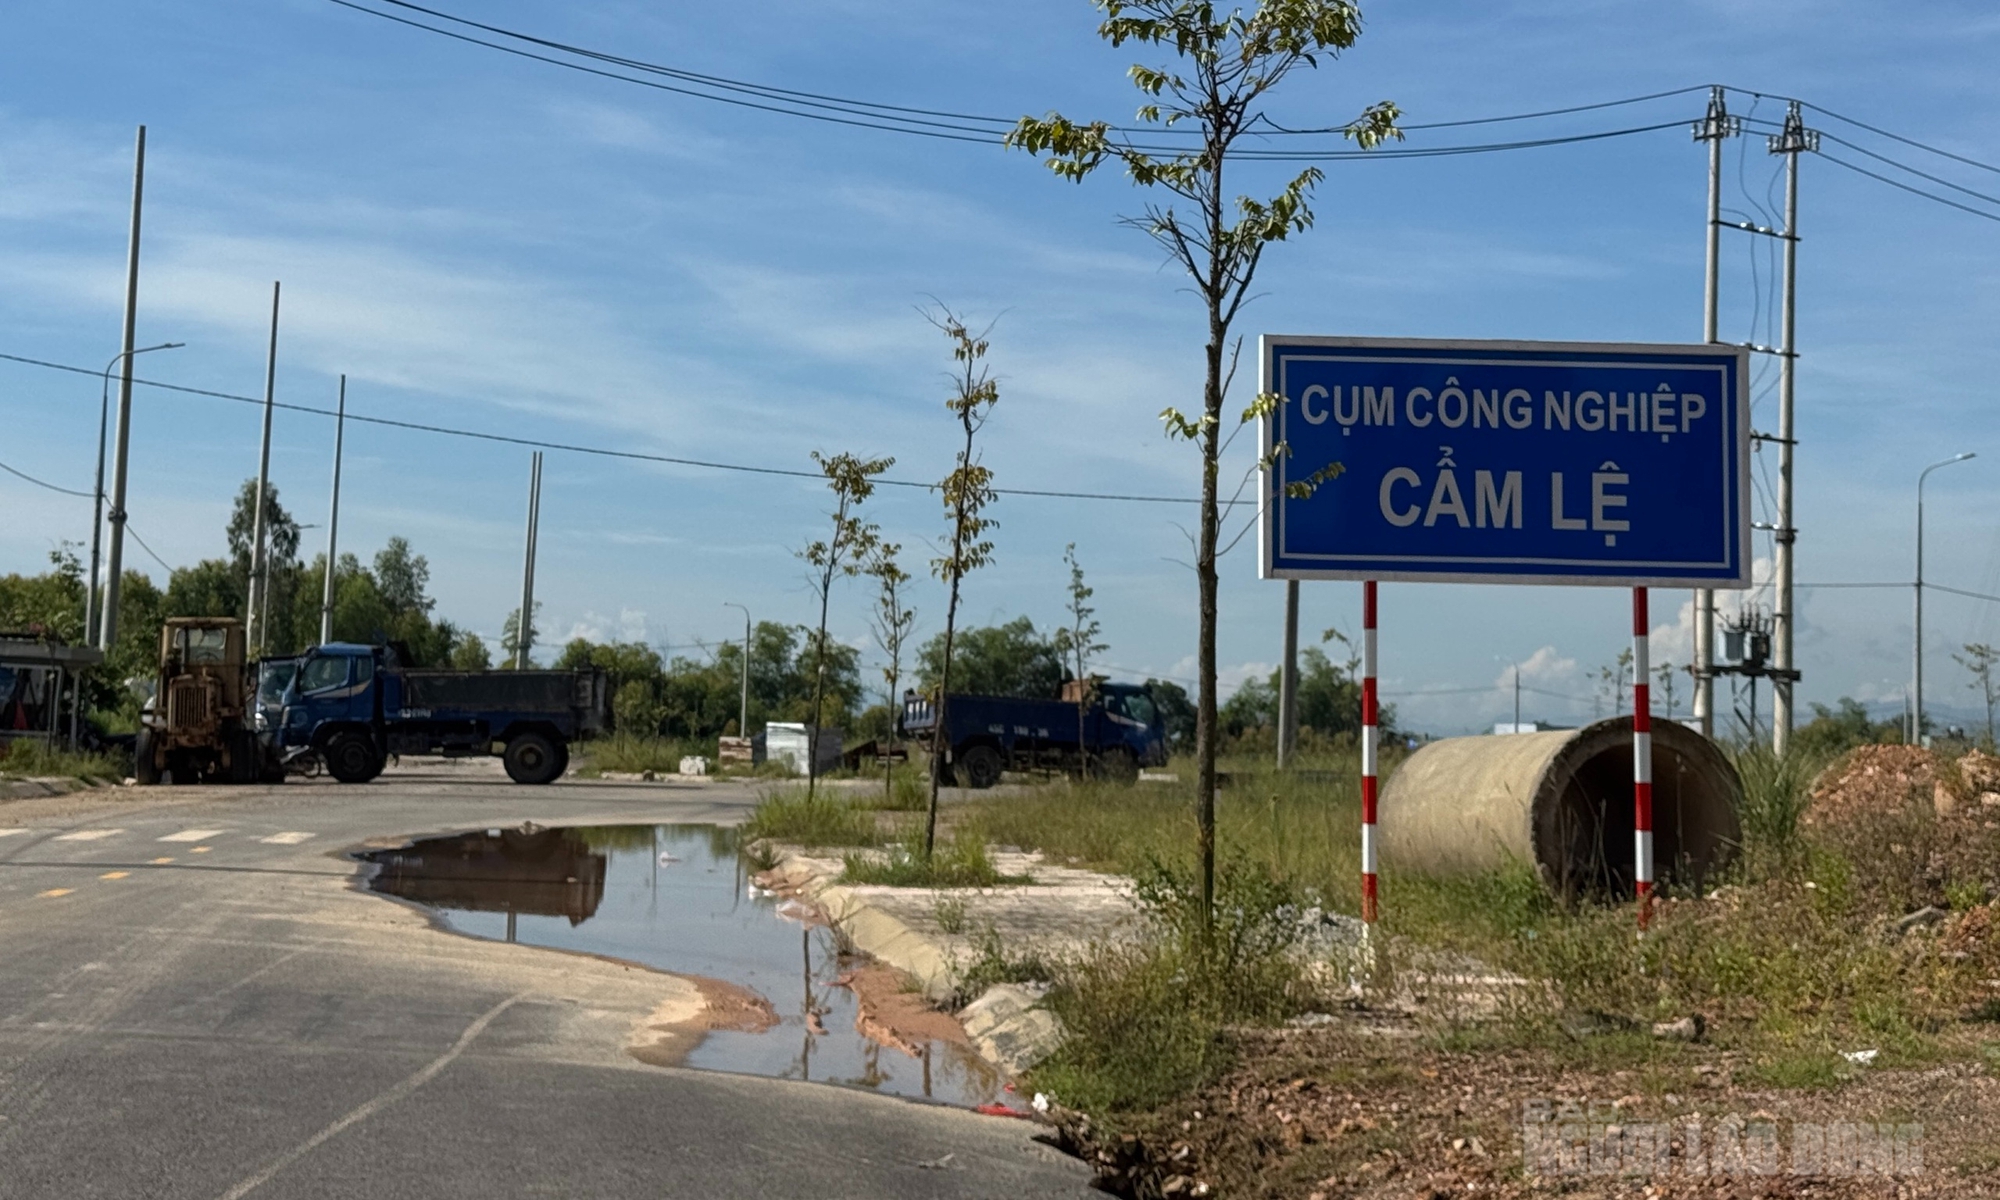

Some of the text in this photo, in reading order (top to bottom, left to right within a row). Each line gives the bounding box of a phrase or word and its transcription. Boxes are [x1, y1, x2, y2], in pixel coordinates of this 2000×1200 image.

[1301, 376, 1707, 443] CỤM CÔNG NGHIỆP
[1379, 446, 1630, 547] CẨM LỆ
